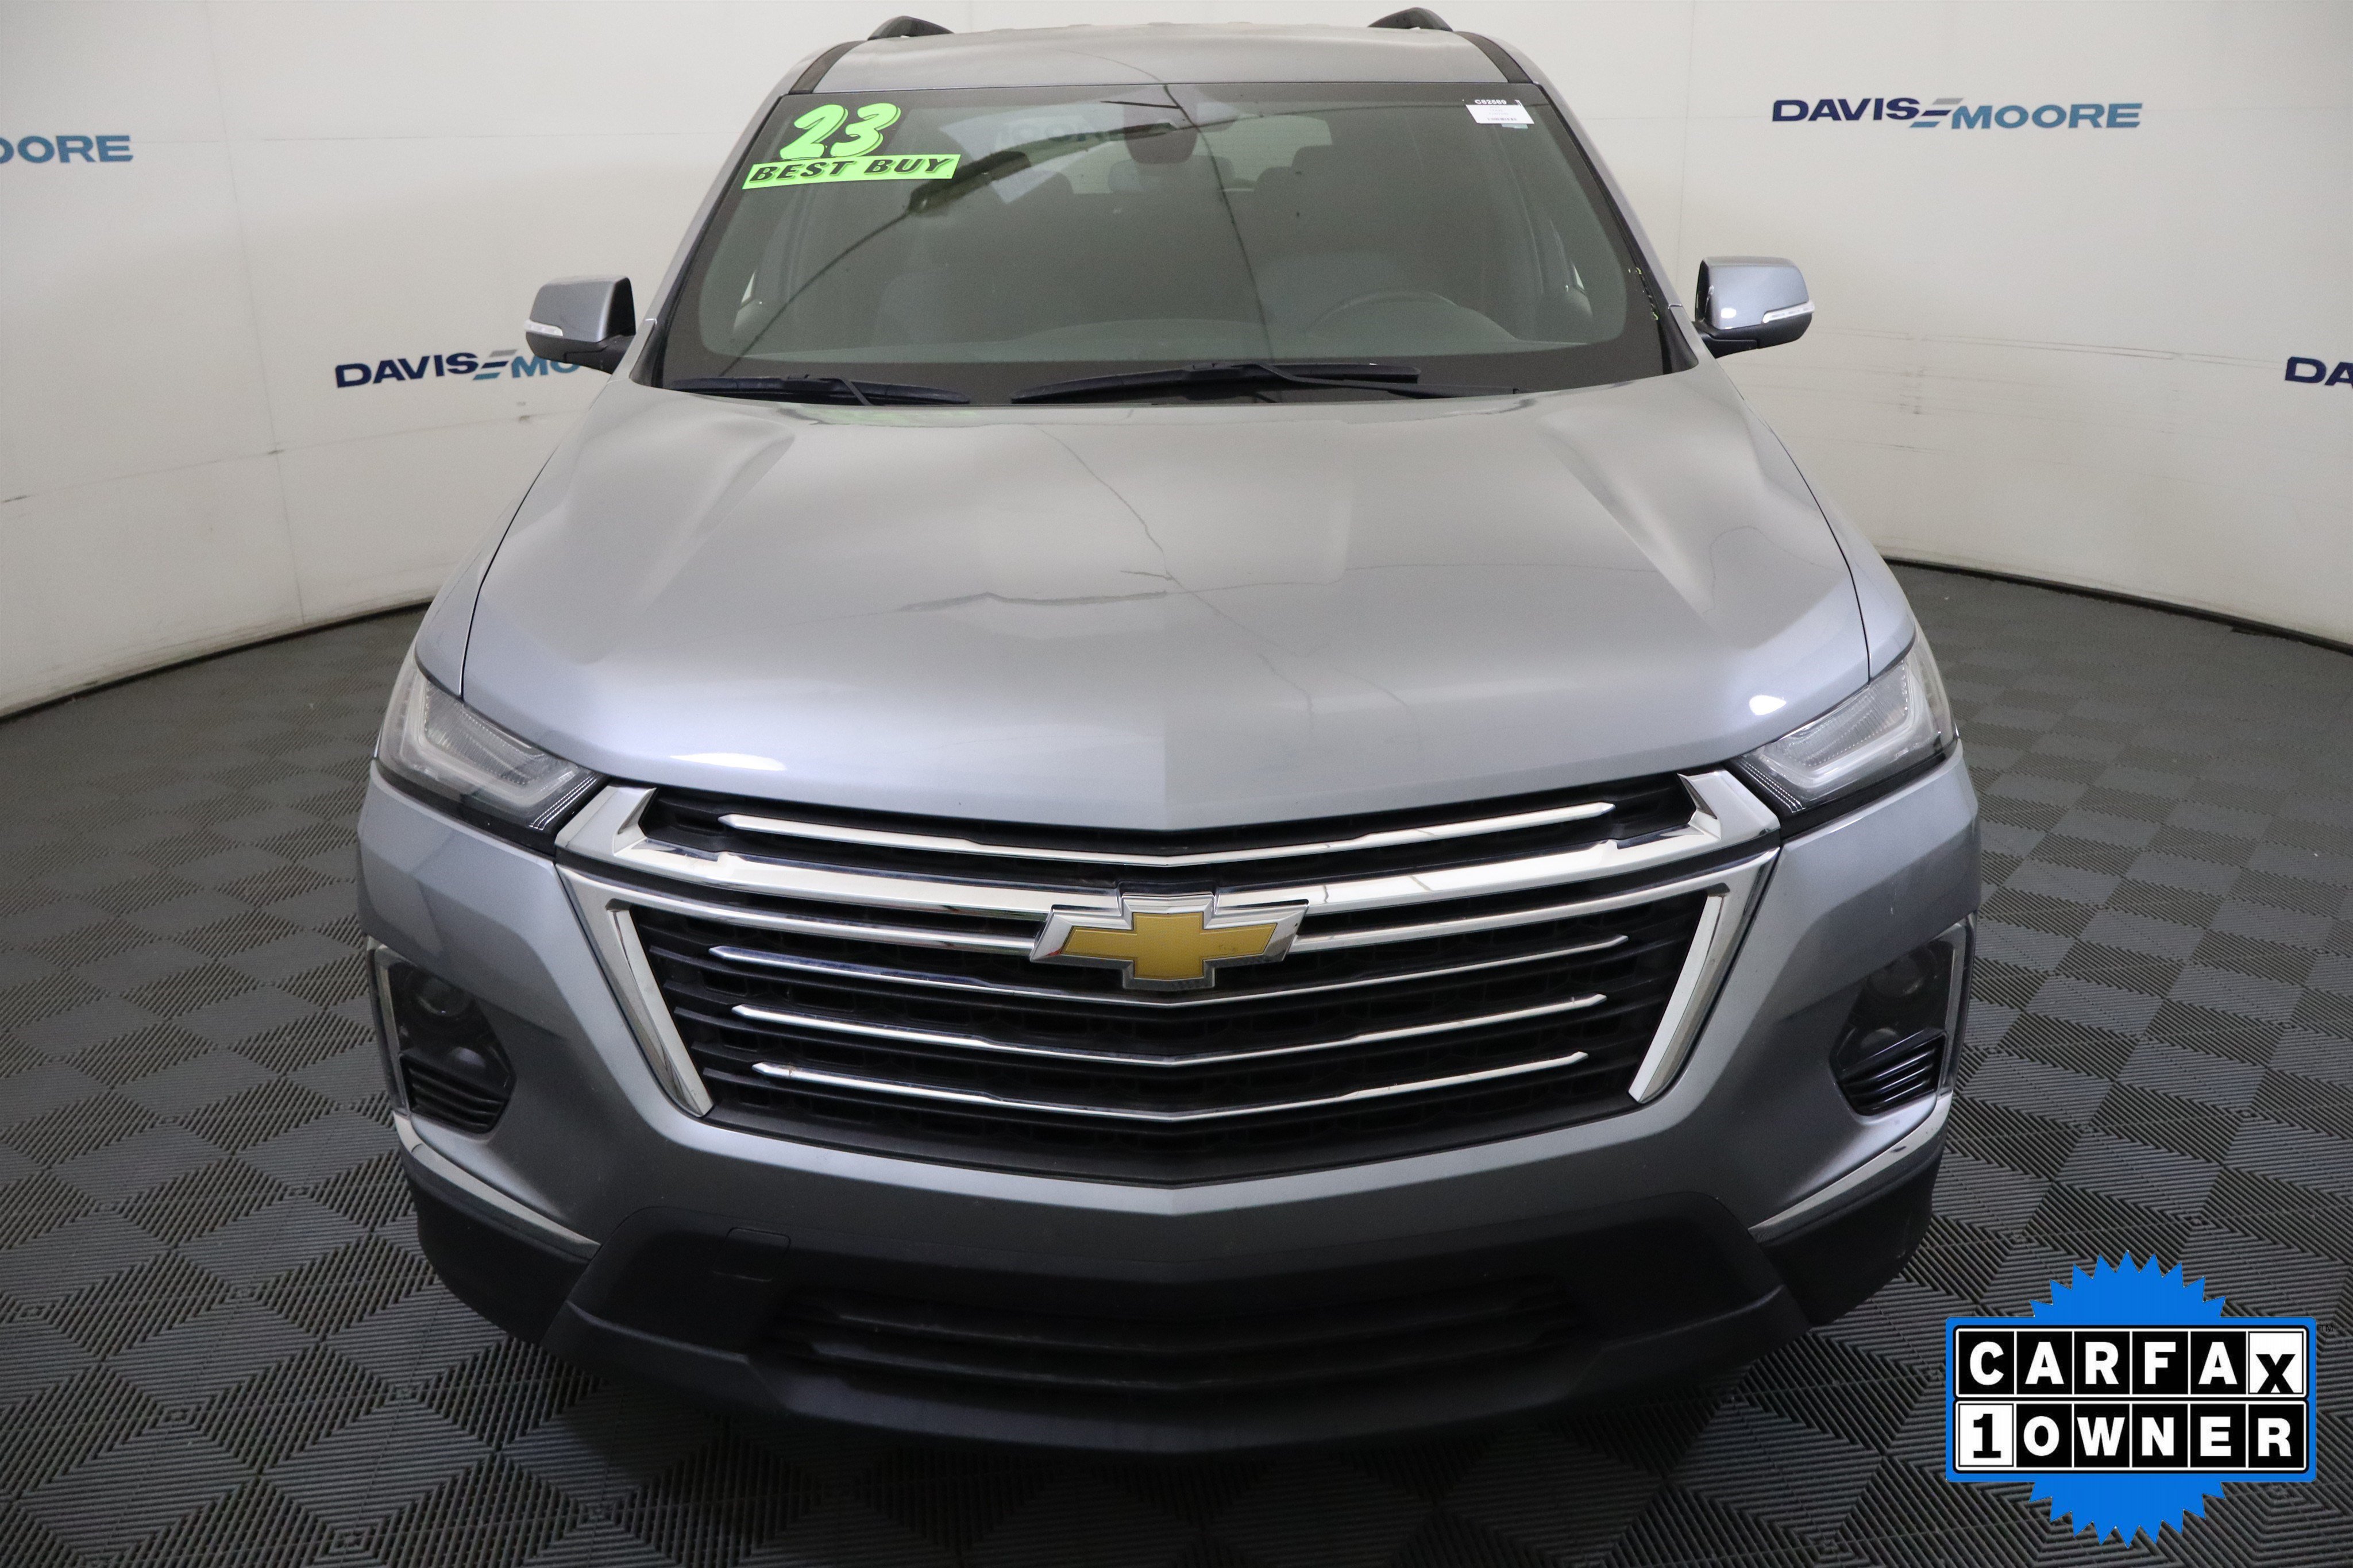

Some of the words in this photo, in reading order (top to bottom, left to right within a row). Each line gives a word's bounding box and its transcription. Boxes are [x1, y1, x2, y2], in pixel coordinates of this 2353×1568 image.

[1772, 97, 1920, 122] DAVIS
[1951, 102, 2143, 129] MOORE
[780, 103, 901, 160] 23
[749, 160, 857, 183] BEST
[863, 158, 955, 175] BUY
[334, 352, 479, 388] DAVIS
